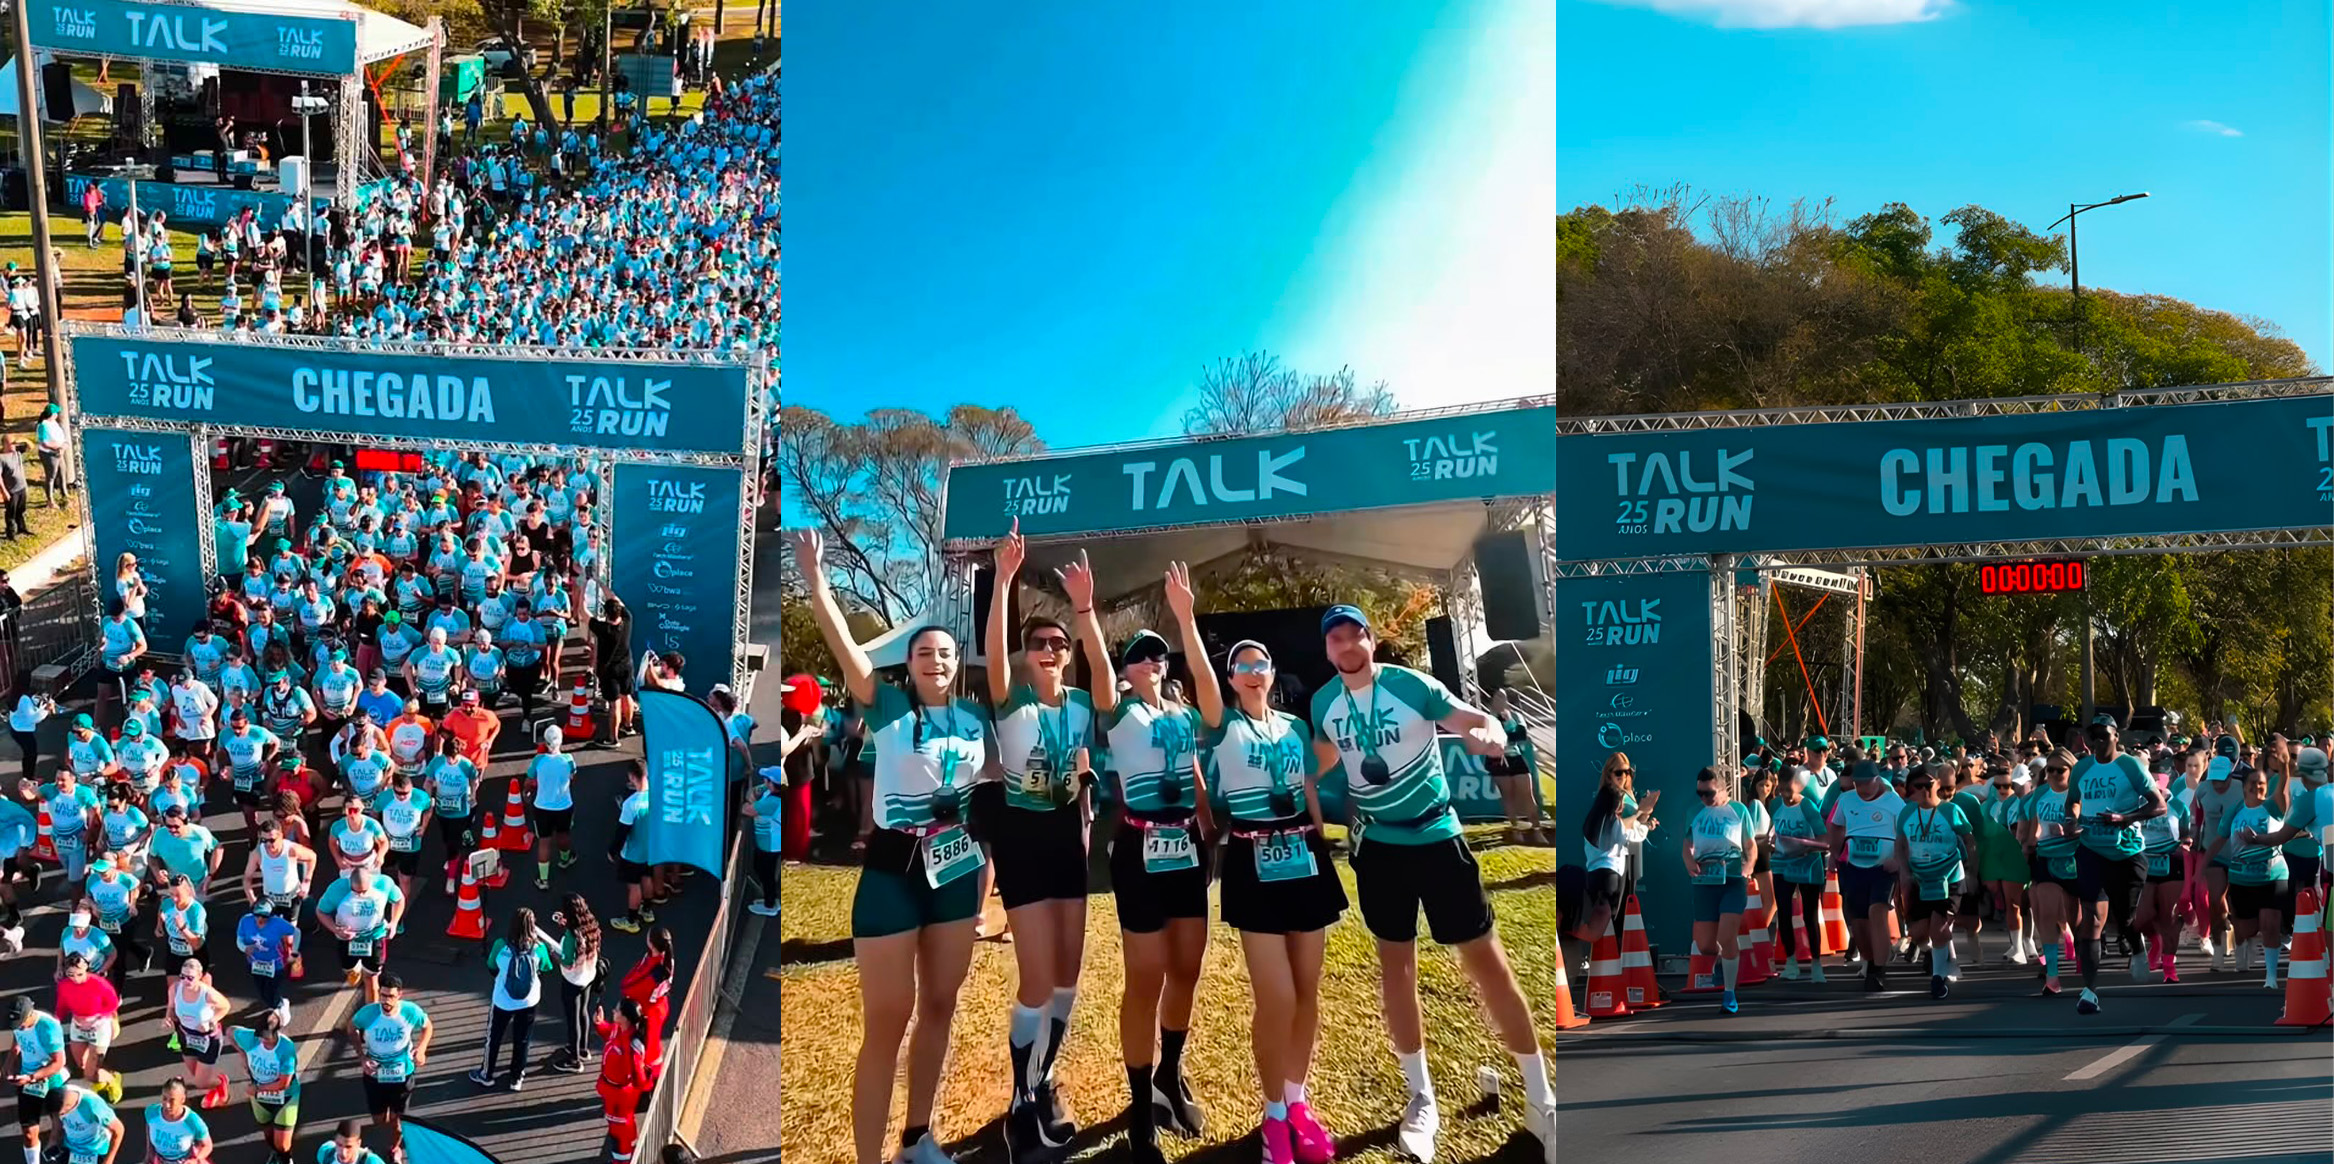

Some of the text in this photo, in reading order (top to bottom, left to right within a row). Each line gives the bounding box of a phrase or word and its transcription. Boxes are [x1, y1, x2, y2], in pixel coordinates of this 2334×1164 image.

[53, 7, 96, 25] TALK
[66, 24, 95, 39] RUN
[125, 11, 228, 54] TALK
[277, 26, 323, 45] TALK
[290, 42, 322, 59] RUN
[172, 187, 216, 204] TALK
[185, 205, 215, 219] RUN
[120, 351, 215, 386] TALK
[129, 382, 215, 410] 25 RUN
[292, 367, 496, 424] CHEGADA
[565, 374, 672, 411] TALK
[570, 409, 669, 437] 25 RUN
[112, 443, 162, 461] TALK
[1402, 430, 1498, 461] TALK
[129, 460, 162, 475] RUN
[1122, 445, 1308, 511] TALK
[1410, 455, 1497, 480] 25 RUN
[1607, 448, 1755, 496] TALK
[1880, 434, 2200, 517] CHEGADA
[648, 480, 706, 499] TALK
[1003, 473, 1072, 499] TALK
[649, 497, 704, 514] 25 RUN
[1004, 495, 1069, 515] 25 RUN
[1616, 495, 1753, 534] 25 RUN
[1981, 562, 2083, 593] 00:00:00
[1582, 598, 1662, 625] TALK
[1586, 623, 1661, 646] 25 RUN
[671, 749, 684, 768] 25
[662, 771, 685, 823] RUN
[686, 746, 713, 826] TALK
[931, 836, 969, 865] 5886
[1262, 844, 1302, 863] 5031
